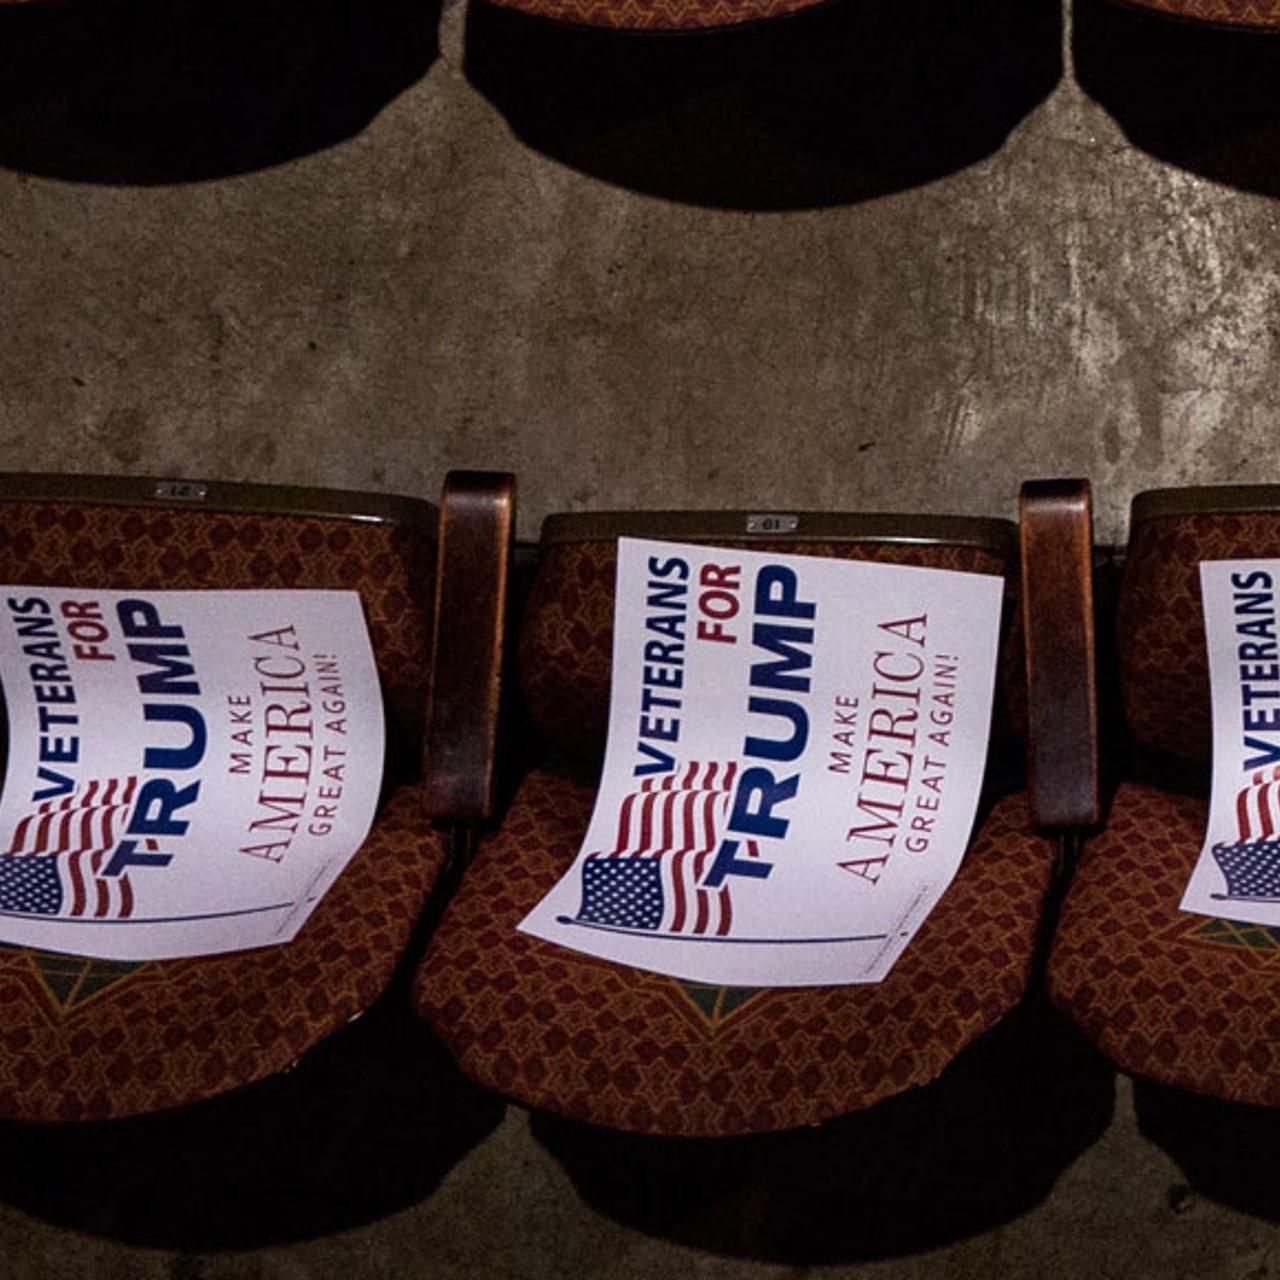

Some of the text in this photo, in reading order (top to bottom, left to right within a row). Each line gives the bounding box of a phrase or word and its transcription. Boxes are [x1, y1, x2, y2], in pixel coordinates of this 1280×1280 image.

[8, 597, 80, 803] VETERANS
[61, 600, 116, 662] FOR
[633, 556, 690, 778] VETERANS
[696, 563, 741, 645] FOR
[101, 599, 208, 878] TRUMP
[228, 694, 252, 774] MAKE
[239, 624, 314, 864] AMERICA
[308, 654, 347, 837] GREAT AGAIN!
[703, 564, 817, 888] TRUMP
[828, 696, 859, 775] MAKE
[836, 613, 927, 885] AMERICA
[905, 654, 959, 853] GREAT AGAIN!
